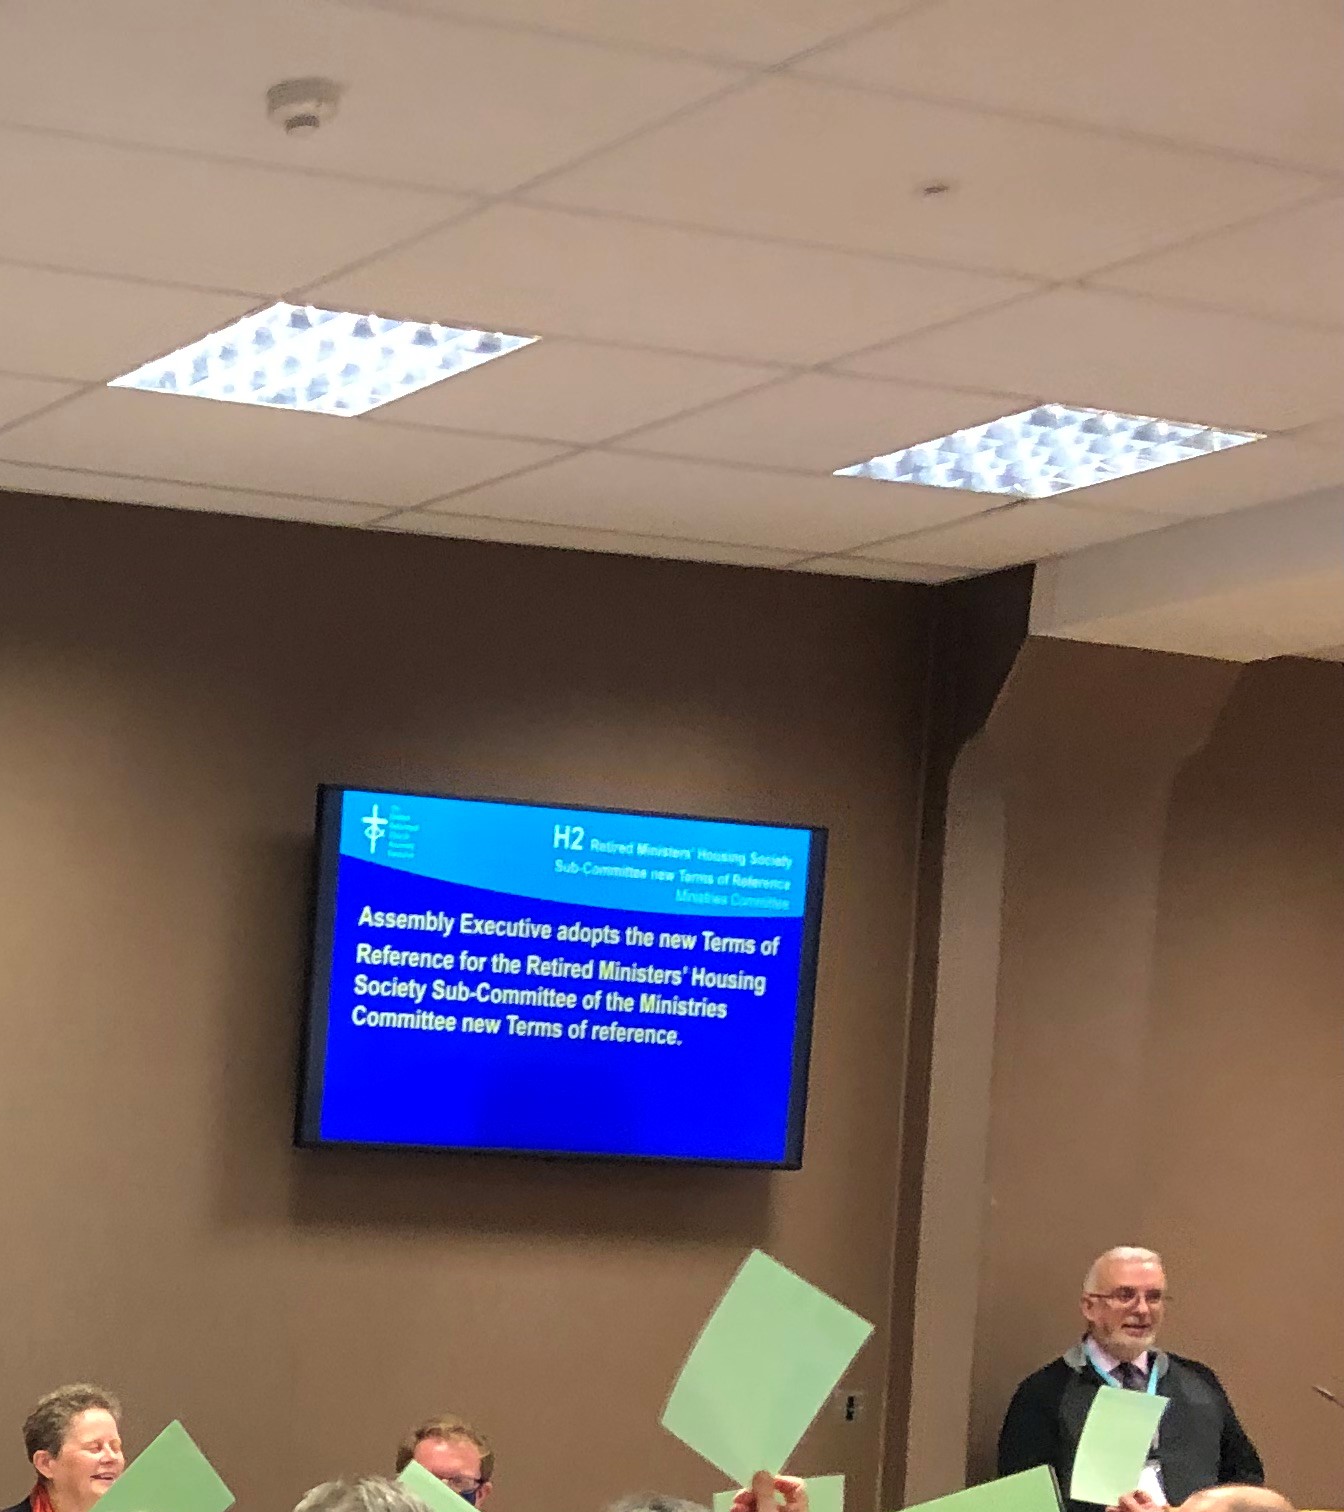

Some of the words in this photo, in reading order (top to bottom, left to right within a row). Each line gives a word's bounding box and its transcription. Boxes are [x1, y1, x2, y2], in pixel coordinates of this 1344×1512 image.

[553, 824, 584, 850] H2
[590, 838, 633, 854] Retired
[697, 848, 746, 866] Housing
[750, 851, 793, 869] Society
[555, 859, 647, 879] Sub-Committee
[651, 869, 674, 881] new
[679, 869, 714, 885] Terms
[717, 873, 729, 885] of
[732, 874, 791, 891] Reference
[358, 905, 454, 937] Assembly
[460, 913, 552, 939] Executive
[557, 922, 620, 948] adopts
[625, 926, 654, 947] the
[659, 933, 697, 950] new
[702, 931, 756, 954] Terms
[761, 937, 781, 956] of
[356, 943, 454, 969] Reference
[460, 950, 487, 972] for
[491, 953, 521, 974] the
[526, 955, 593, 979] Retired
[599, 960, 688, 985] Ministers'
[692, 967, 766, 996] Housing
[354, 974, 427, 1004] Society
[432, 979, 577, 1008] Sub-Committee
[582, 990, 603, 1010] of
[606, 991, 634, 1012] the
[640, 993, 728, 1019] Ministries
[352, 1005, 457, 1032] Committee
[462, 1016, 501, 1034] new
[506, 1015, 562, 1038] Terms
[568, 1020, 588, 1039] of
[591, 1021, 682, 1046] reference.
